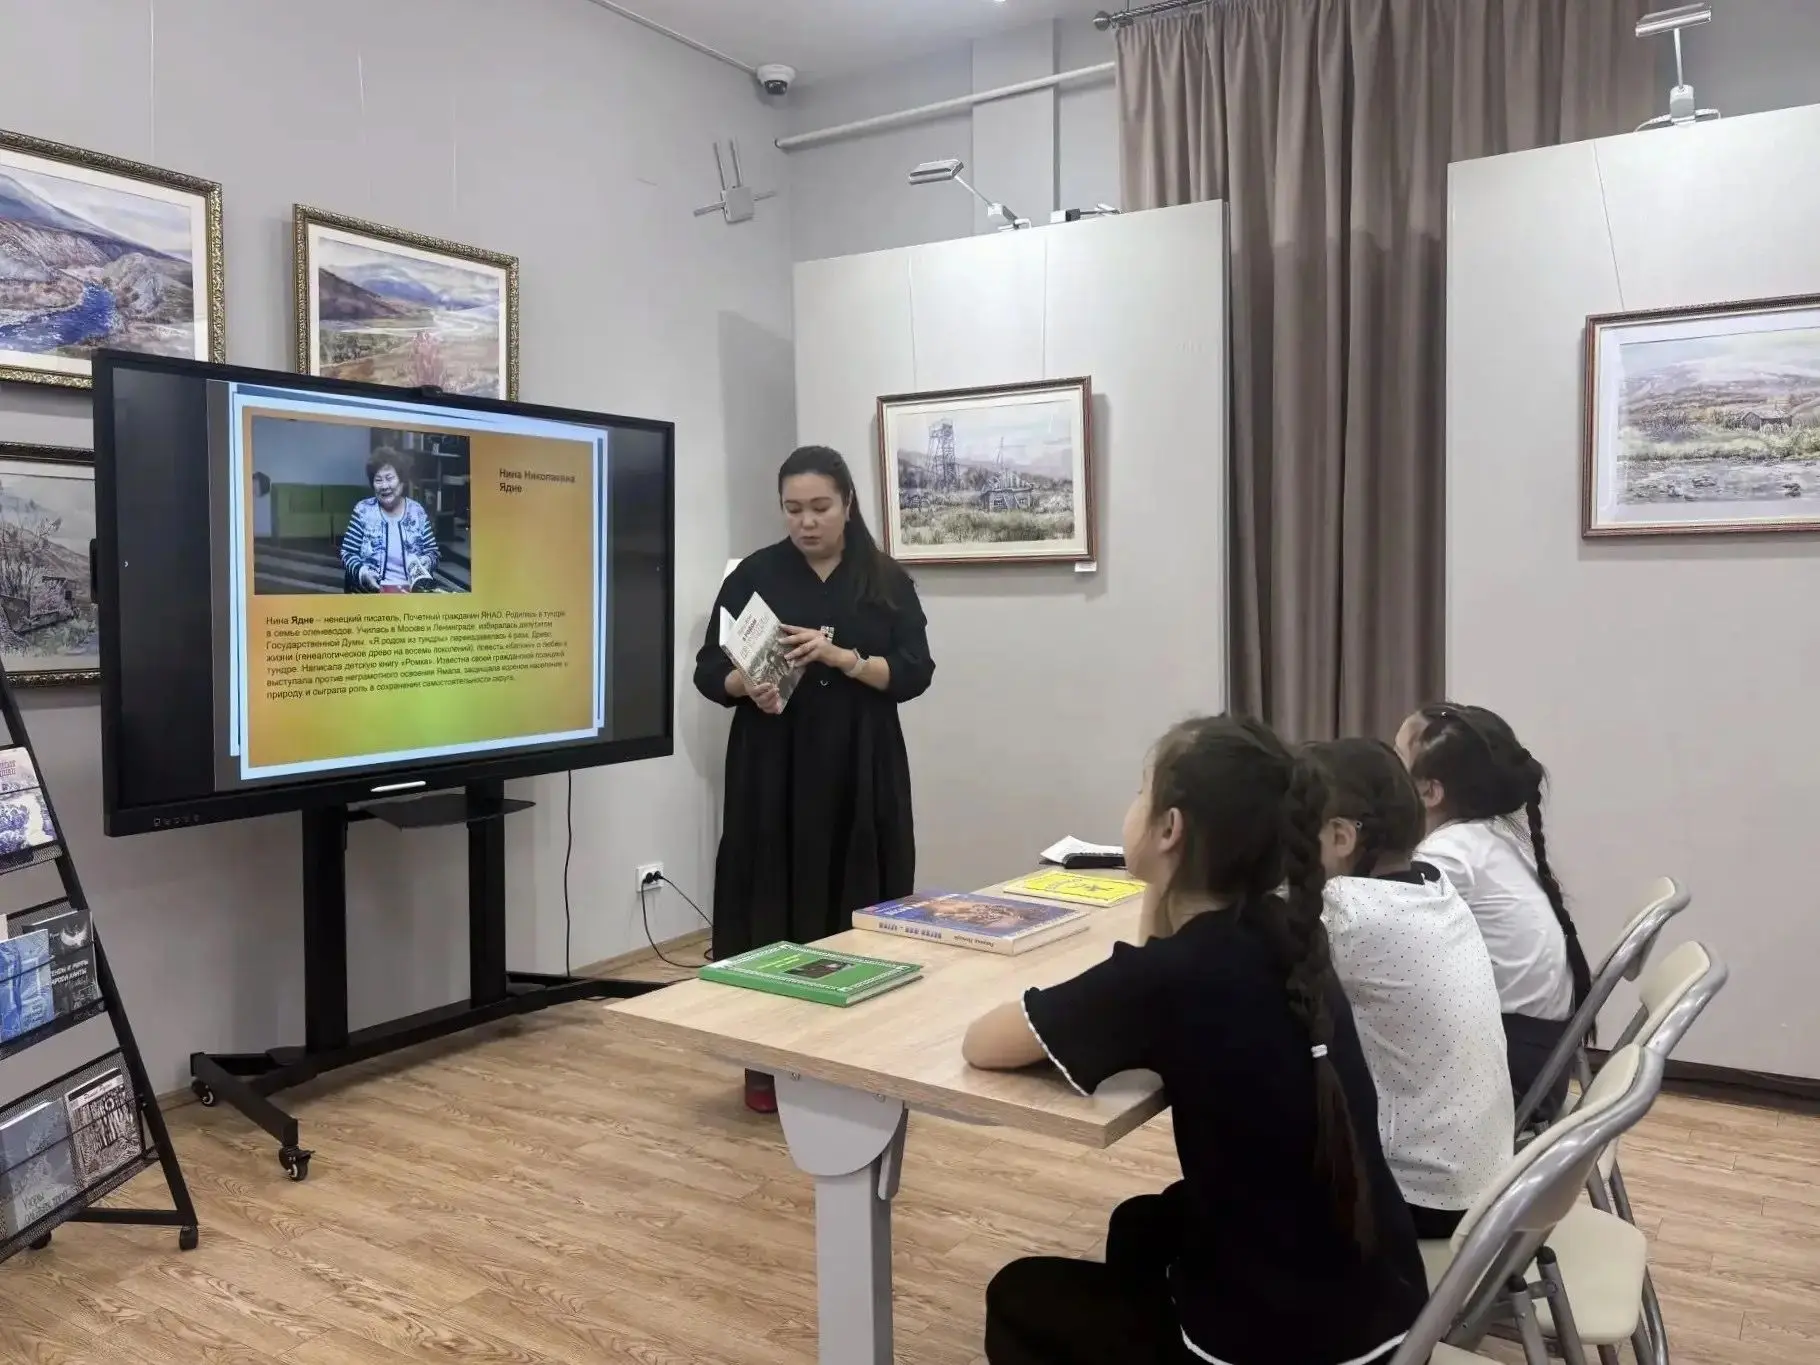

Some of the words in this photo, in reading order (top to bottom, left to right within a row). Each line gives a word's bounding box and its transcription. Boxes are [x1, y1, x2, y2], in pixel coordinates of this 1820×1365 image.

[499, 468, 522, 479] Нина
[499, 482, 523, 493] Ядне
[266, 616, 289, 625] Нина
[291, 615, 314, 625] Ядне
[324, 613, 362, 623] ненецкий
[403, 612, 440, 621] Почетный
[442, 612, 479, 621] гражданин
[274, 629, 300, 637] семье
[357, 625, 389, 634] Училась
[397, 624, 425, 633] Москве
[478, 621, 518, 630] избиралась
[266, 639, 340, 651] Государственной
[381, 637, 406, 646] родом
[266, 653, 293, 662] жизни
[295, 650, 367, 662] (генеалогическое
[368, 648, 392, 659] древо
[405, 647, 431, 656] восемь
[301, 663, 343, 673] Написала
[344, 661, 377, 671] детскую
[379, 659, 399, 669] книгу
[436, 655, 470, 665] Известна
[471, 653, 491, 662] своей
[266, 677, 313, 688] выступала
[315, 674, 344, 685] против
[266, 689, 303, 700] природу
[312, 686, 347, 697] сыграла
[348, 685, 368, 695] роль
[376, 681, 421, 692] сохранении
